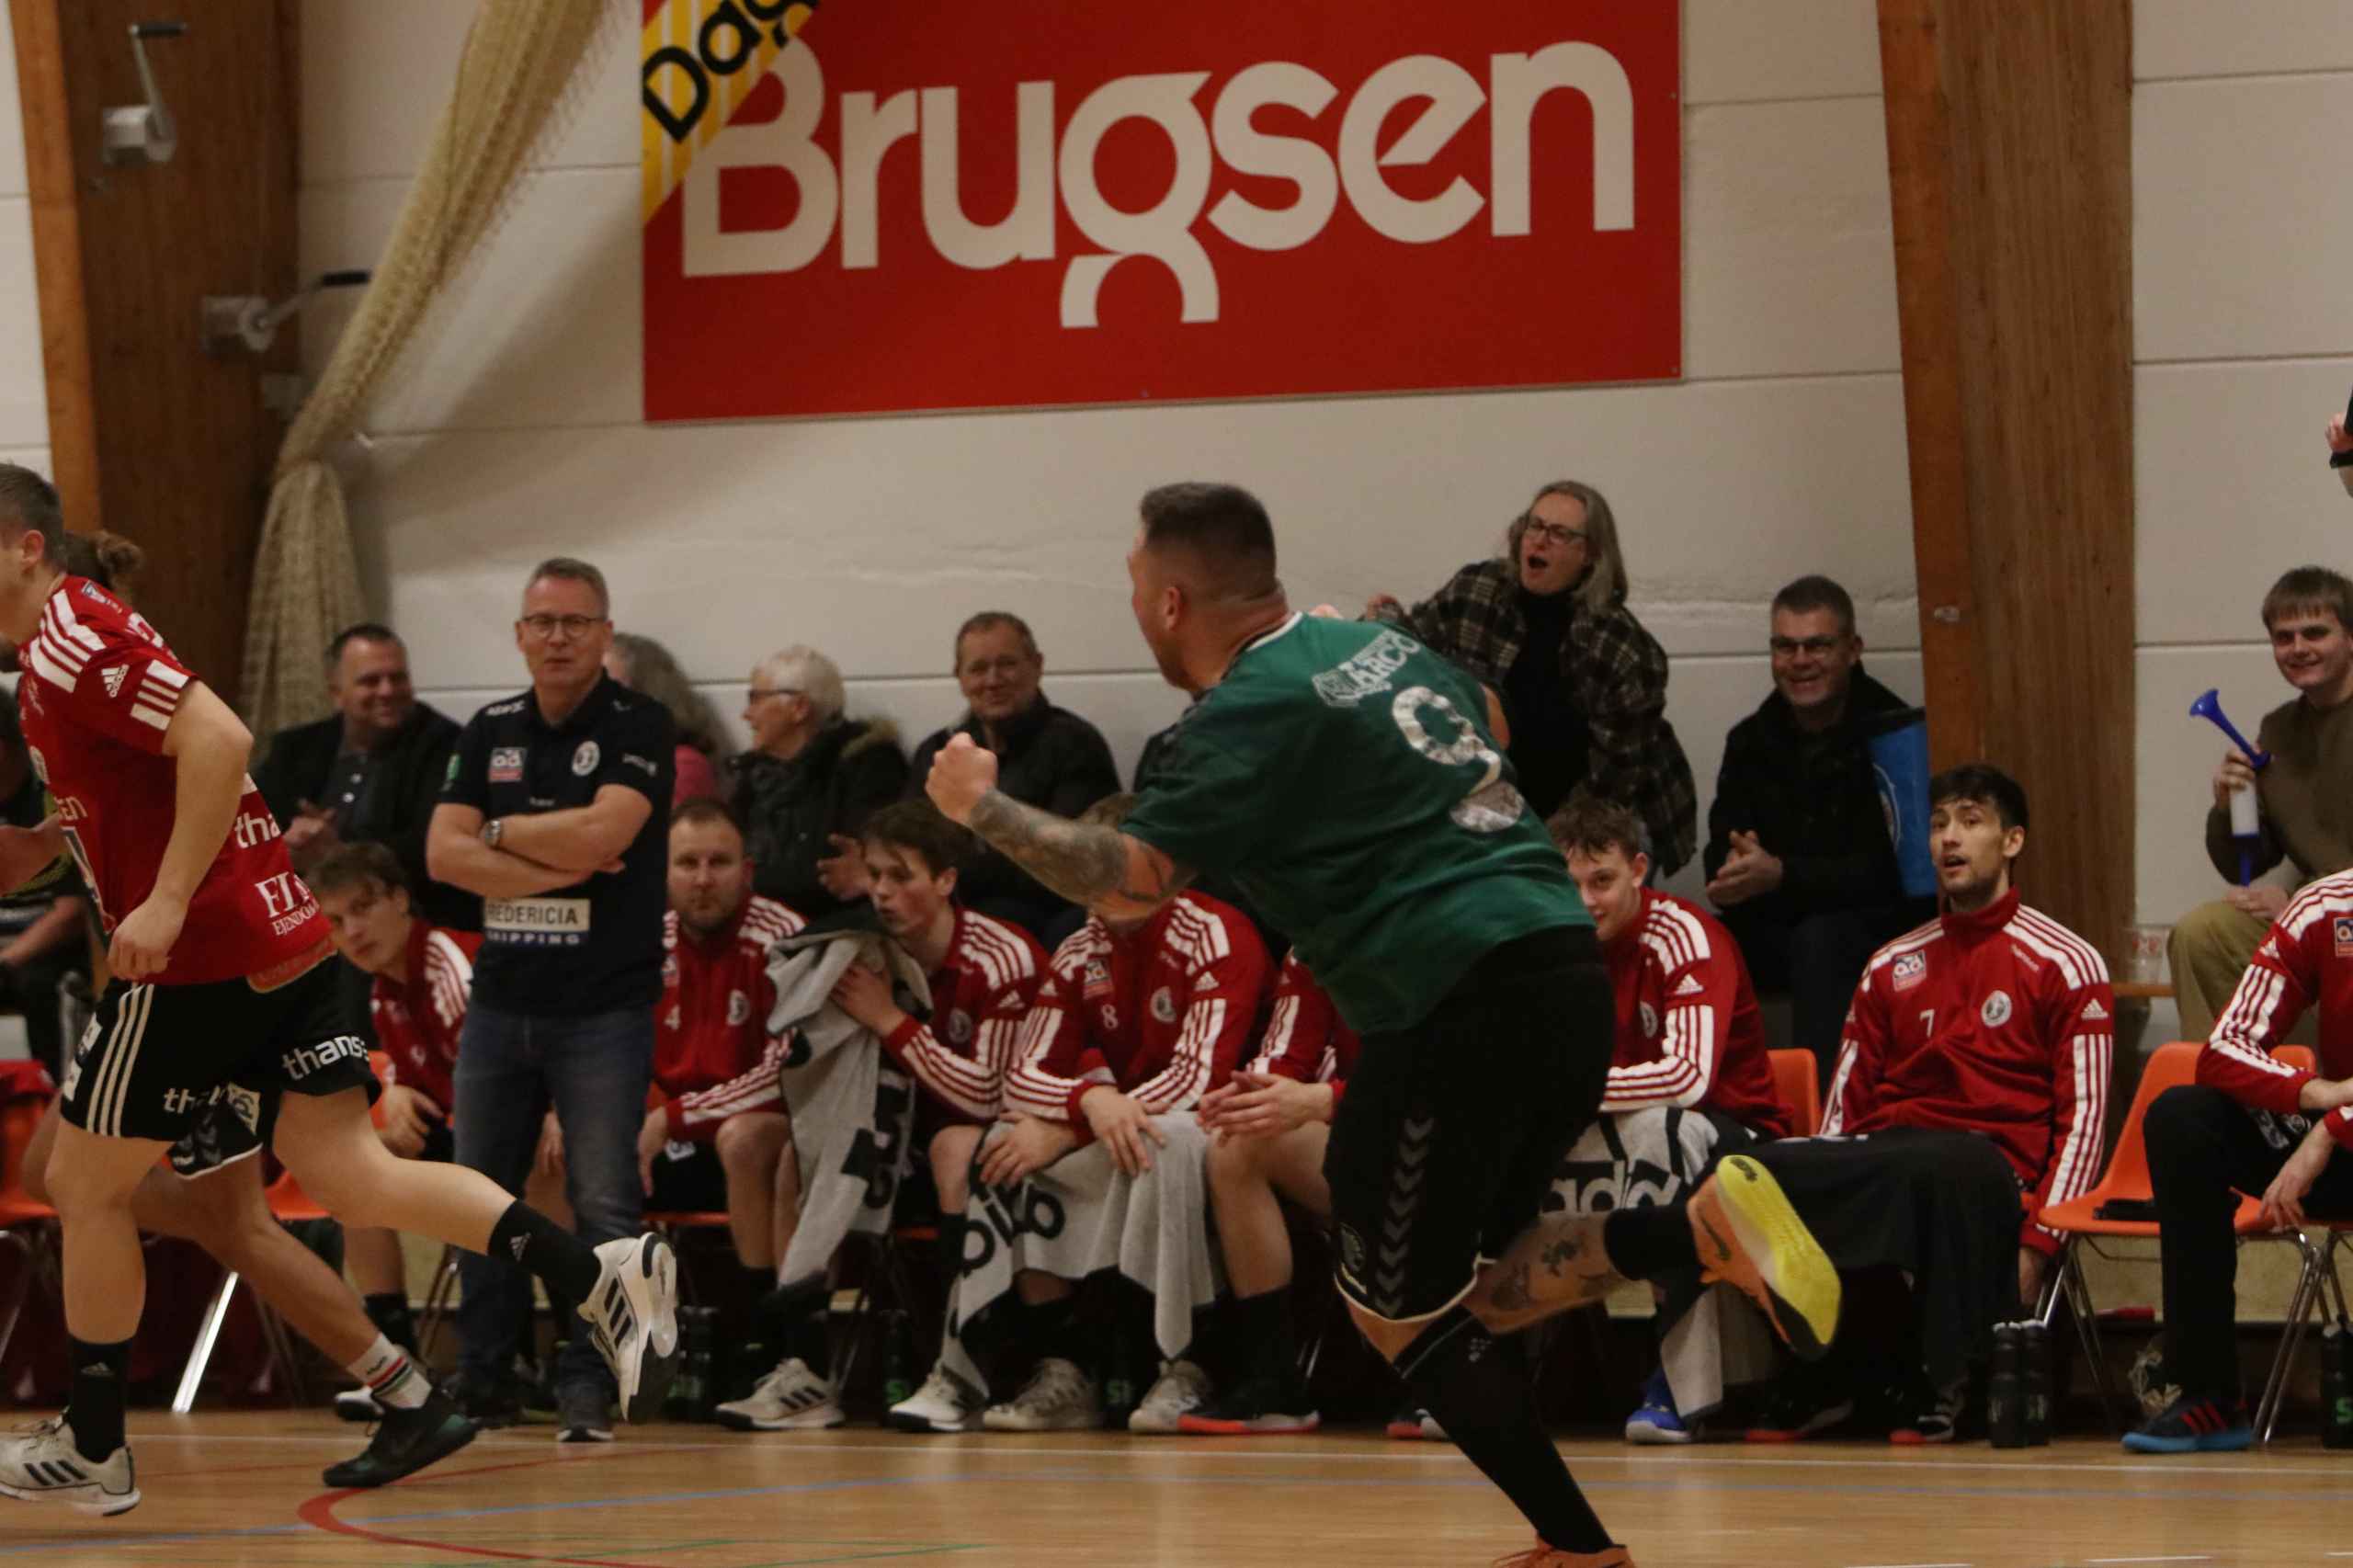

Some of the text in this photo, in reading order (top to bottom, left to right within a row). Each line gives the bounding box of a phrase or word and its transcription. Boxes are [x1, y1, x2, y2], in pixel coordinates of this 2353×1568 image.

[682, 37, 1634, 329] Brugsen
[1101, 1004, 1119, 1028] 8
[1919, 1008, 1935, 1037] 7
